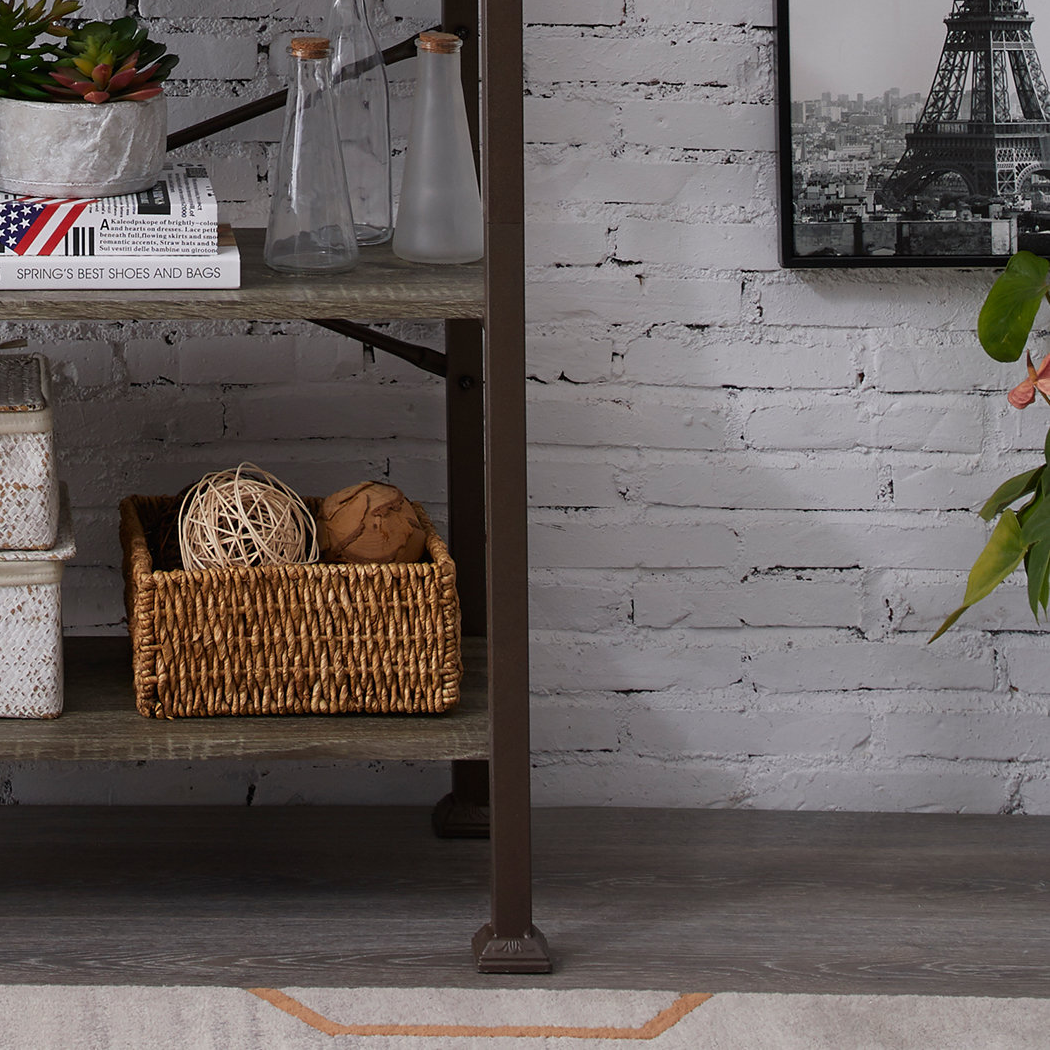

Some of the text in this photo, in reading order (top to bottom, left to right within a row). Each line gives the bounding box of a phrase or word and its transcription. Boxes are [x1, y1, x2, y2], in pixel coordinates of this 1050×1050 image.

[100, 218, 110, 230] A
[16, 268, 74, 280] SPRING'S
[78, 268, 104, 279] BEST
[108, 268, 150, 279] SHOES
[153, 268, 182, 279] AND
[186, 267, 221, 279] BAGS
